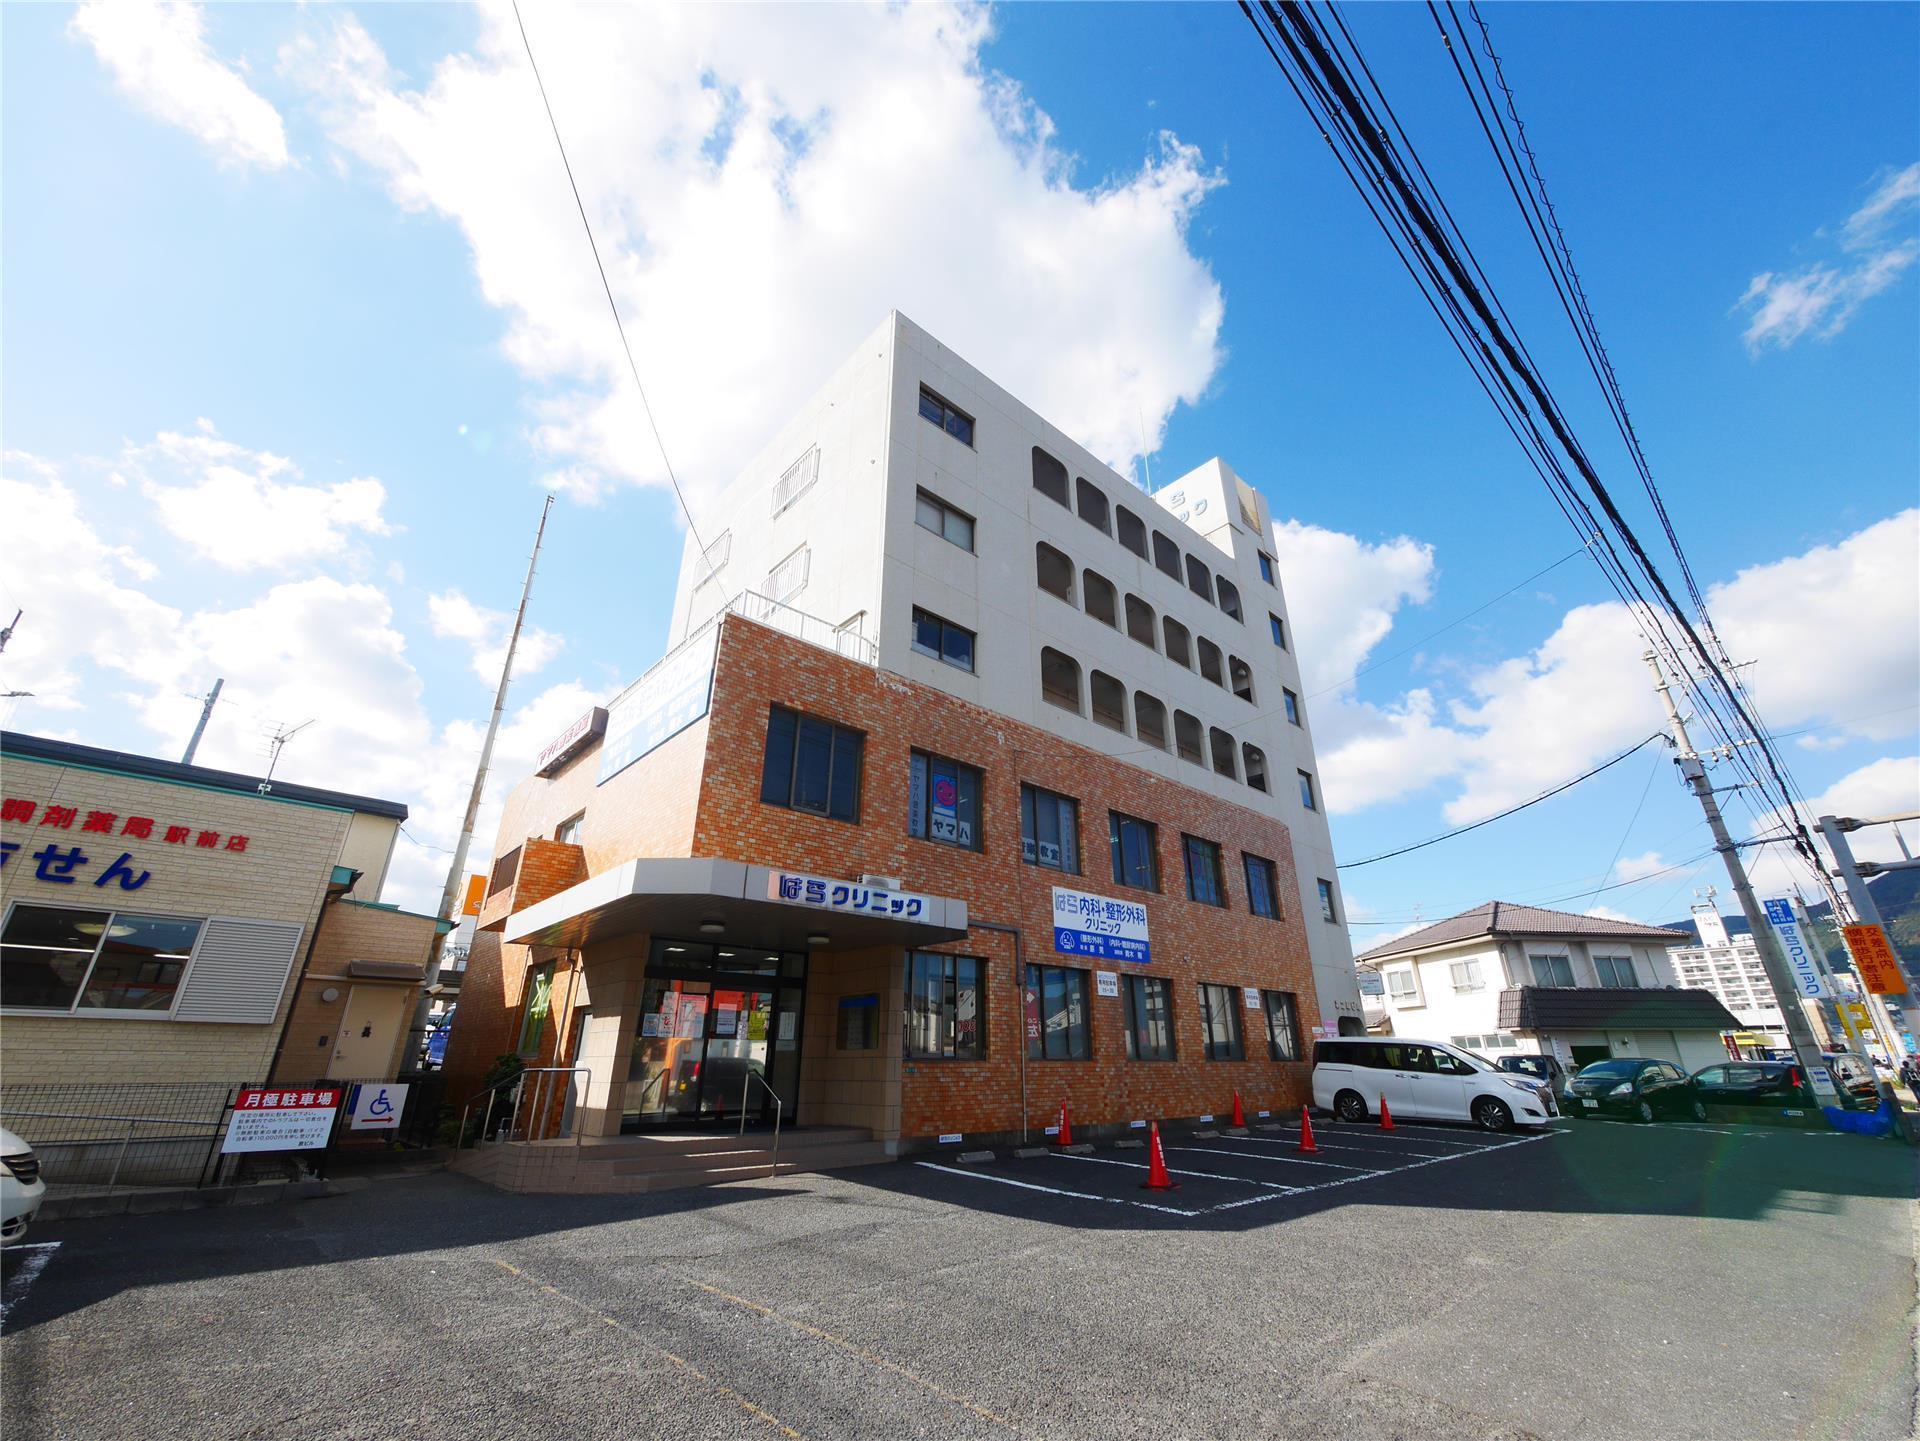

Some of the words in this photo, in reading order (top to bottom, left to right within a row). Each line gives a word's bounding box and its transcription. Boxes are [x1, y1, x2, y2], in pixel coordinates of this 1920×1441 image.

[0, 798, 155, 839] 調剤薬局
[163, 825, 250, 853] 駅前店
[933, 818, 969, 840] ヤマハ
[779, 874, 922, 917] はらクリニック
[1054, 891, 1146, 927] はら内科・整形外科
[1084, 917, 1122, 935] クリニック
[1779, 925, 1820, 994] はらクリニック
[1866, 927, 1895, 970] 交差点内
[244, 1092, 333, 1108] 月極駐車場
